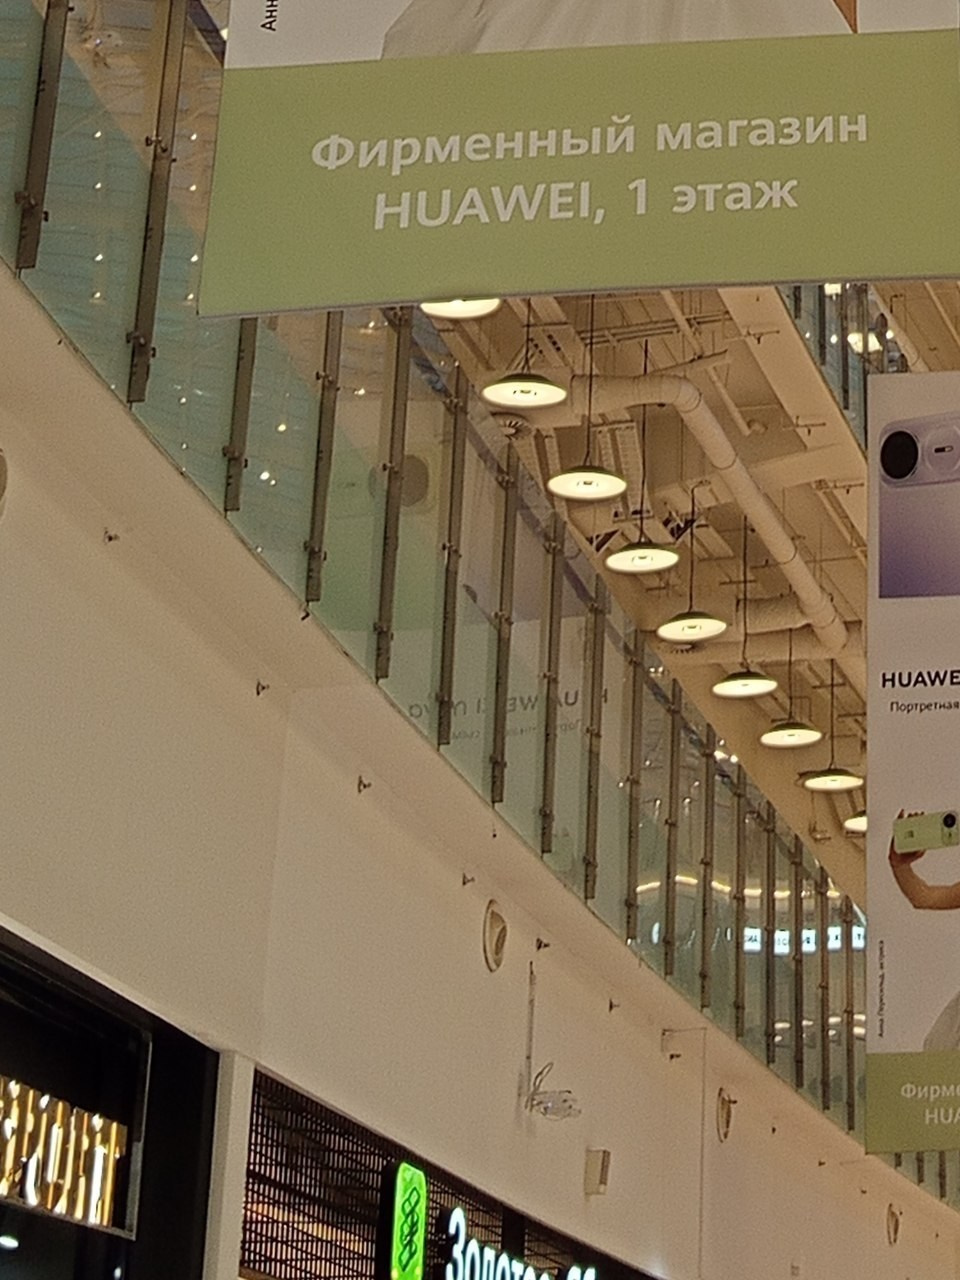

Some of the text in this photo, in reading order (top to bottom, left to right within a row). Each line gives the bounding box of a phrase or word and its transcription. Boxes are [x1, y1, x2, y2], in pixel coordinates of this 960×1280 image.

[311, 114, 867, 175] Фирменный магазин
[374, 179, 798, 229] HUAWEI, 1 этаж
[890, 700, 959, 715] Портретная
